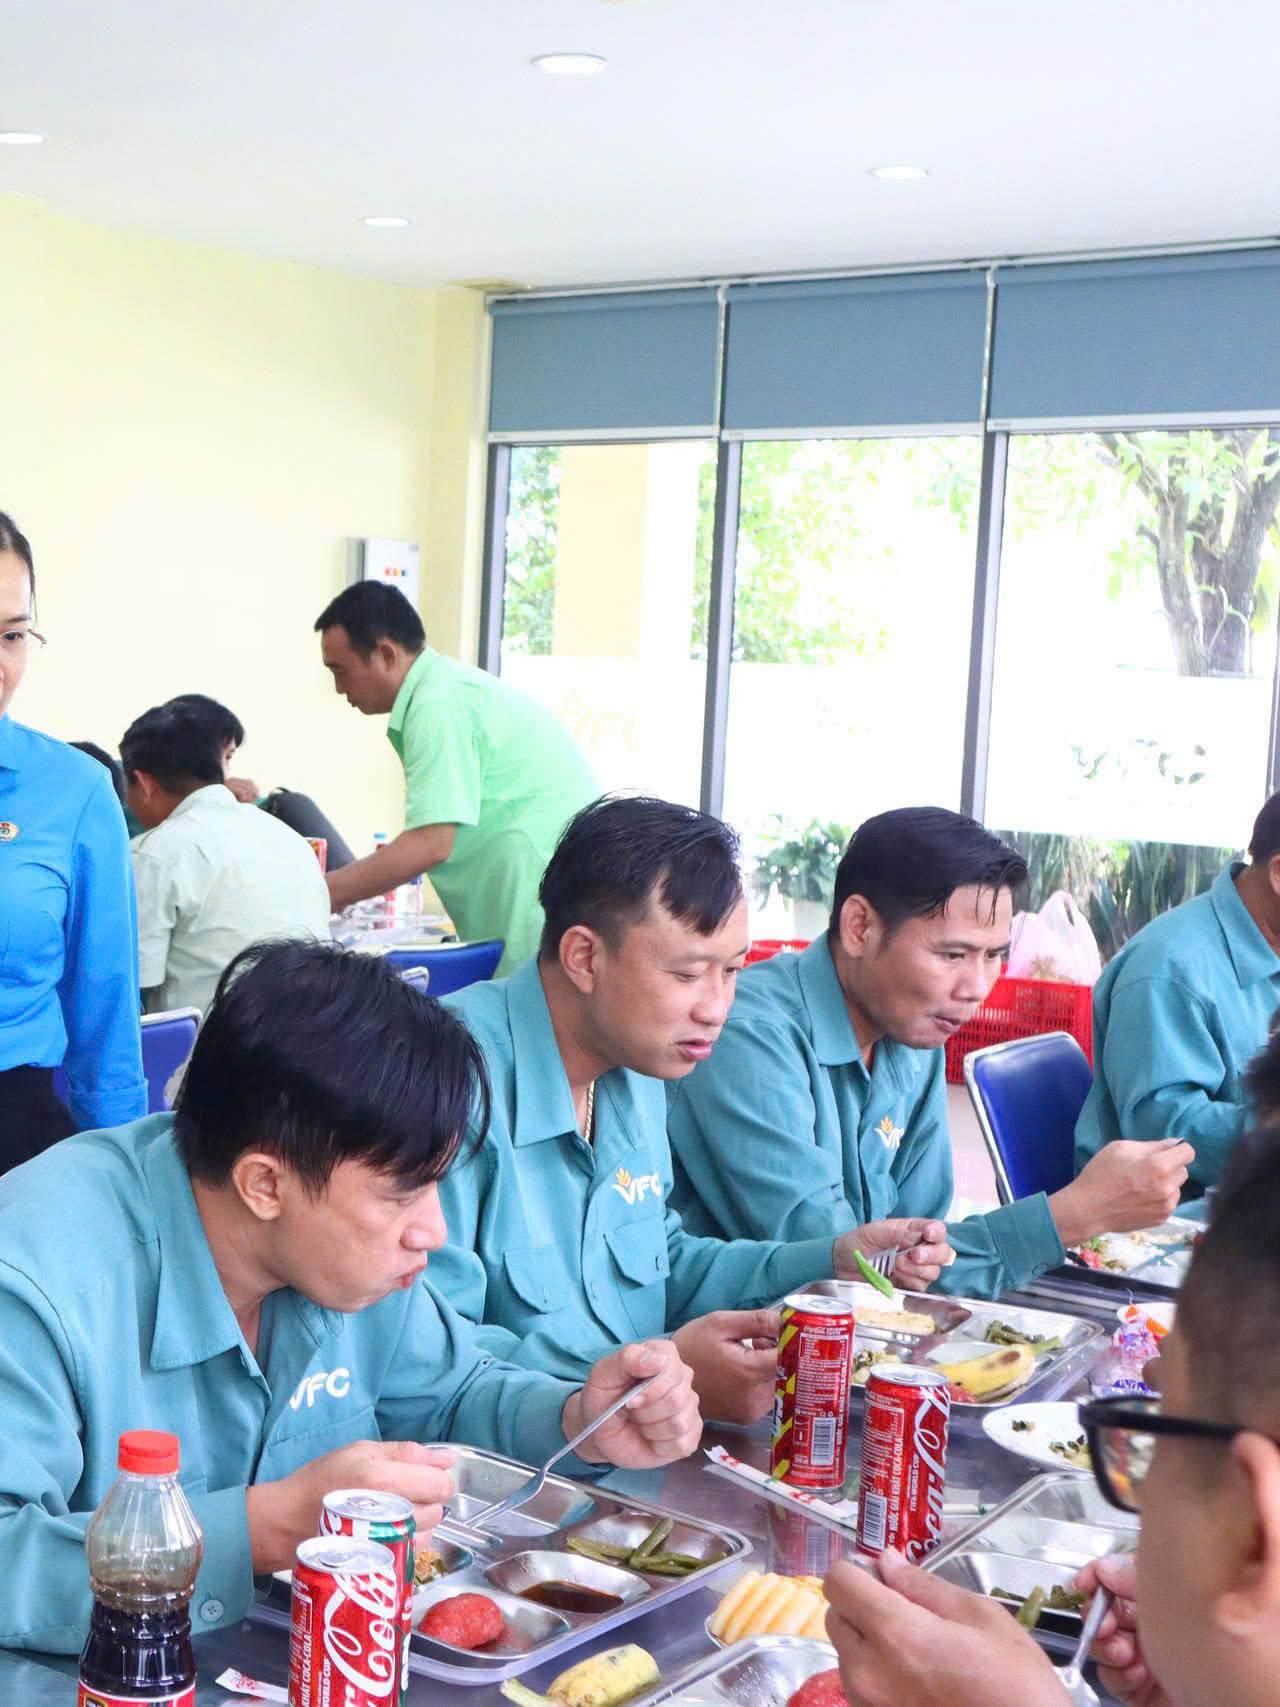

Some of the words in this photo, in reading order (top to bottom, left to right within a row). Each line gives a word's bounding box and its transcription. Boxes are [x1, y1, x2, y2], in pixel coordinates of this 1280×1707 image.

[611, 1172, 663, 1205] VFC
[891, 1437, 904, 1476] COCA-COLA
[301, 1633, 313, 1683] COCA-COLA
[323, 1657, 332, 1678] CUP
